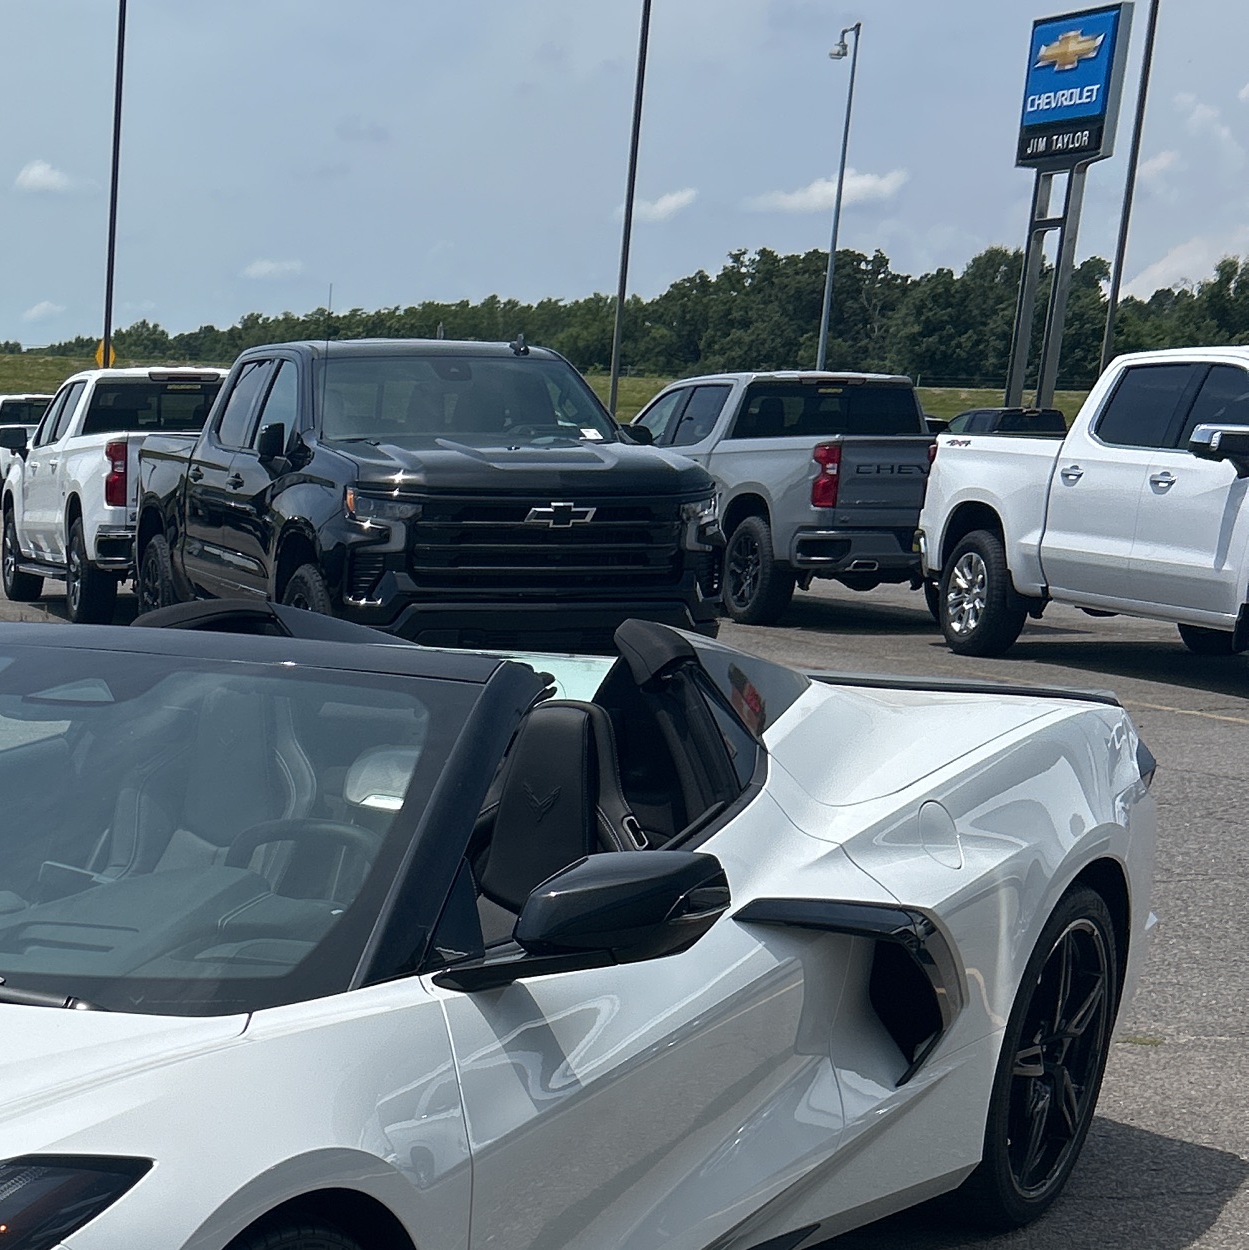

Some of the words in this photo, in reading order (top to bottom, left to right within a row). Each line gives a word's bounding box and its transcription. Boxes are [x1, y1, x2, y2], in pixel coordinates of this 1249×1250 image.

[1027, 84, 1100, 112] CHEVROLET
[1027, 137, 1047, 154] JIM
[1052, 130, 1090, 150] TAYLOR
